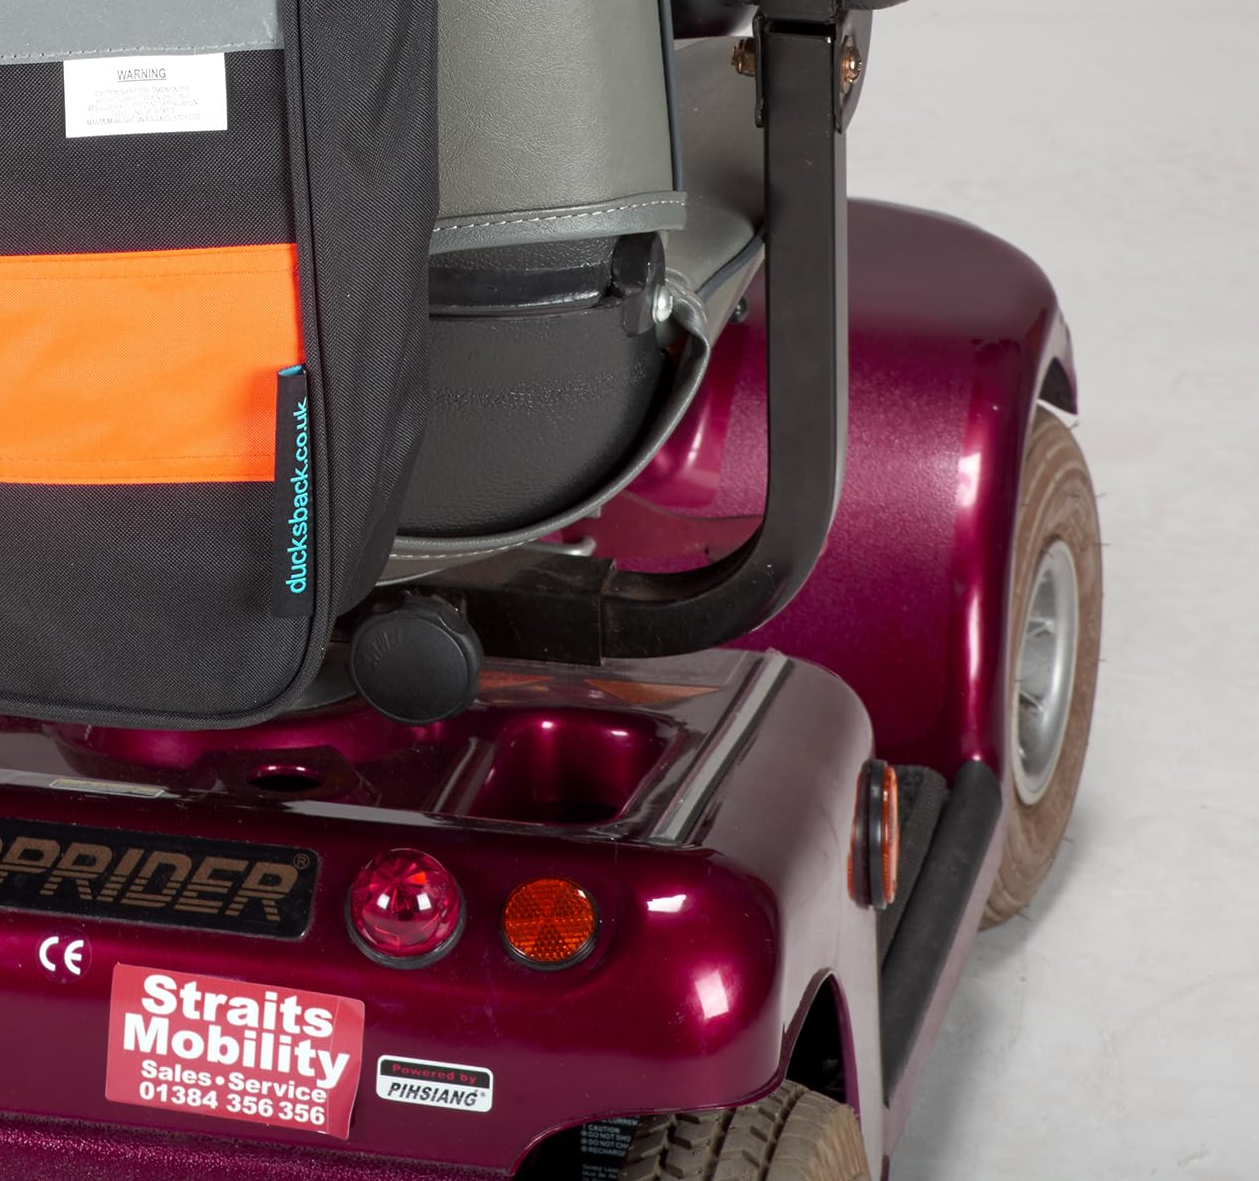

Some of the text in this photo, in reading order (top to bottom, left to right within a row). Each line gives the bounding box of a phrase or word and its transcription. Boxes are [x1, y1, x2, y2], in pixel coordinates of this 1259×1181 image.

[117, 68, 167, 81] WARNING
[285, 397, 309, 594] ducksback.co.uk
[39, 936, 84, 975] CE
[142, 974, 334, 1038] Straits
[123, 1013, 350, 1089] Mobility
[392, 1064, 477, 1085] Powered by
[139, 1082, 326, 1126] 01384 356 356
[588, 1124, 620, 1133] CAUTION
